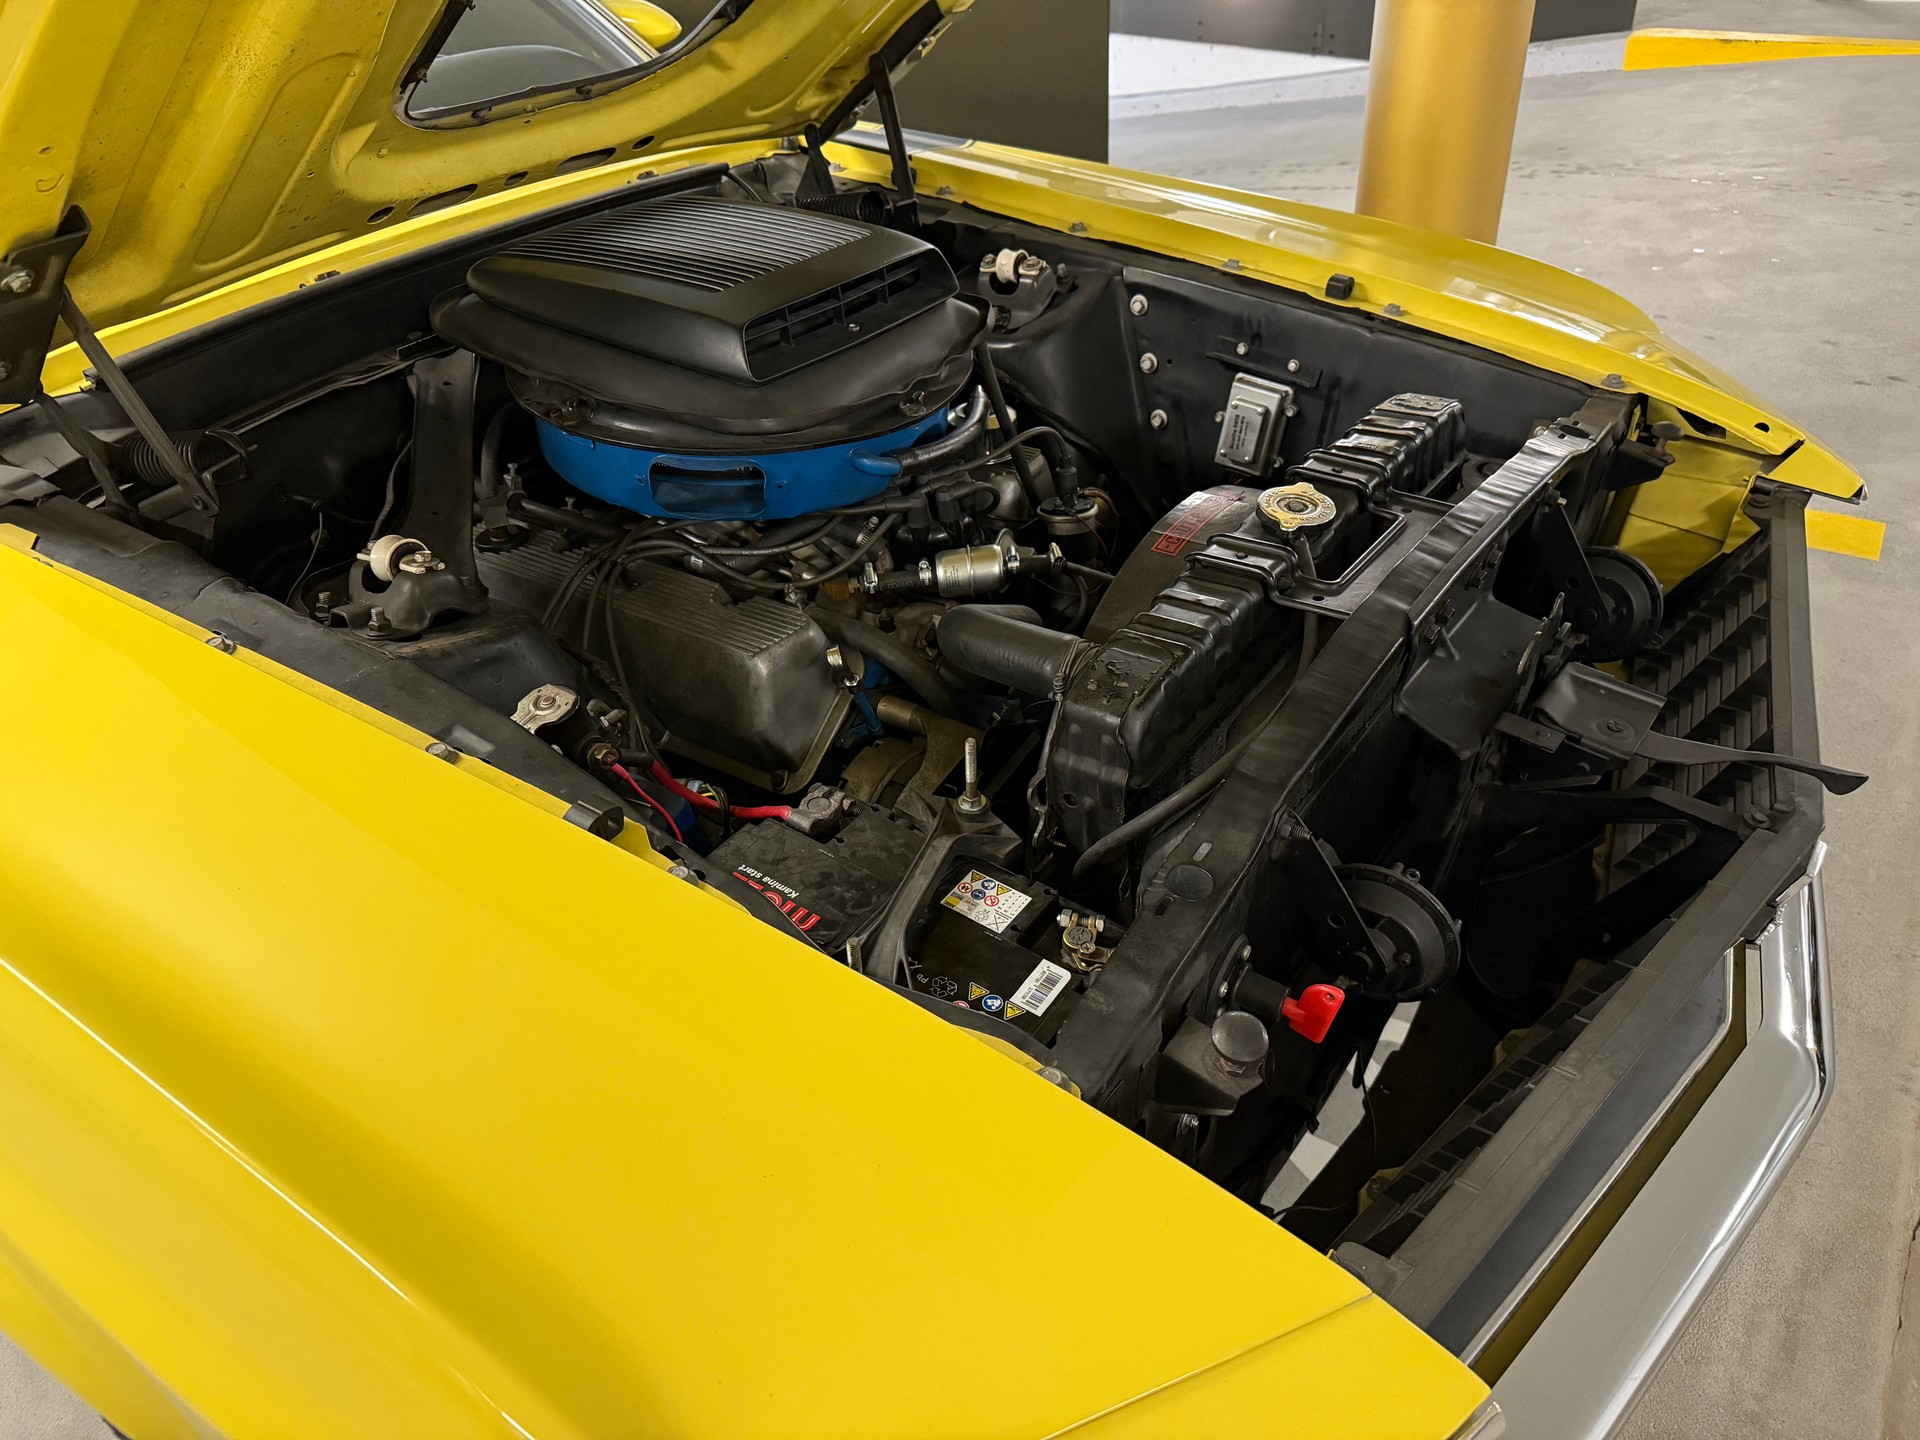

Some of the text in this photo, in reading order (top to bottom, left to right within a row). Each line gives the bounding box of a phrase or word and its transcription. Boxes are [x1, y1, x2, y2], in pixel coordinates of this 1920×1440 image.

[738, 864, 800, 899] Kamina start
[943, 900, 957, 909] ADAC
[916, 973, 930, 984] Pb
